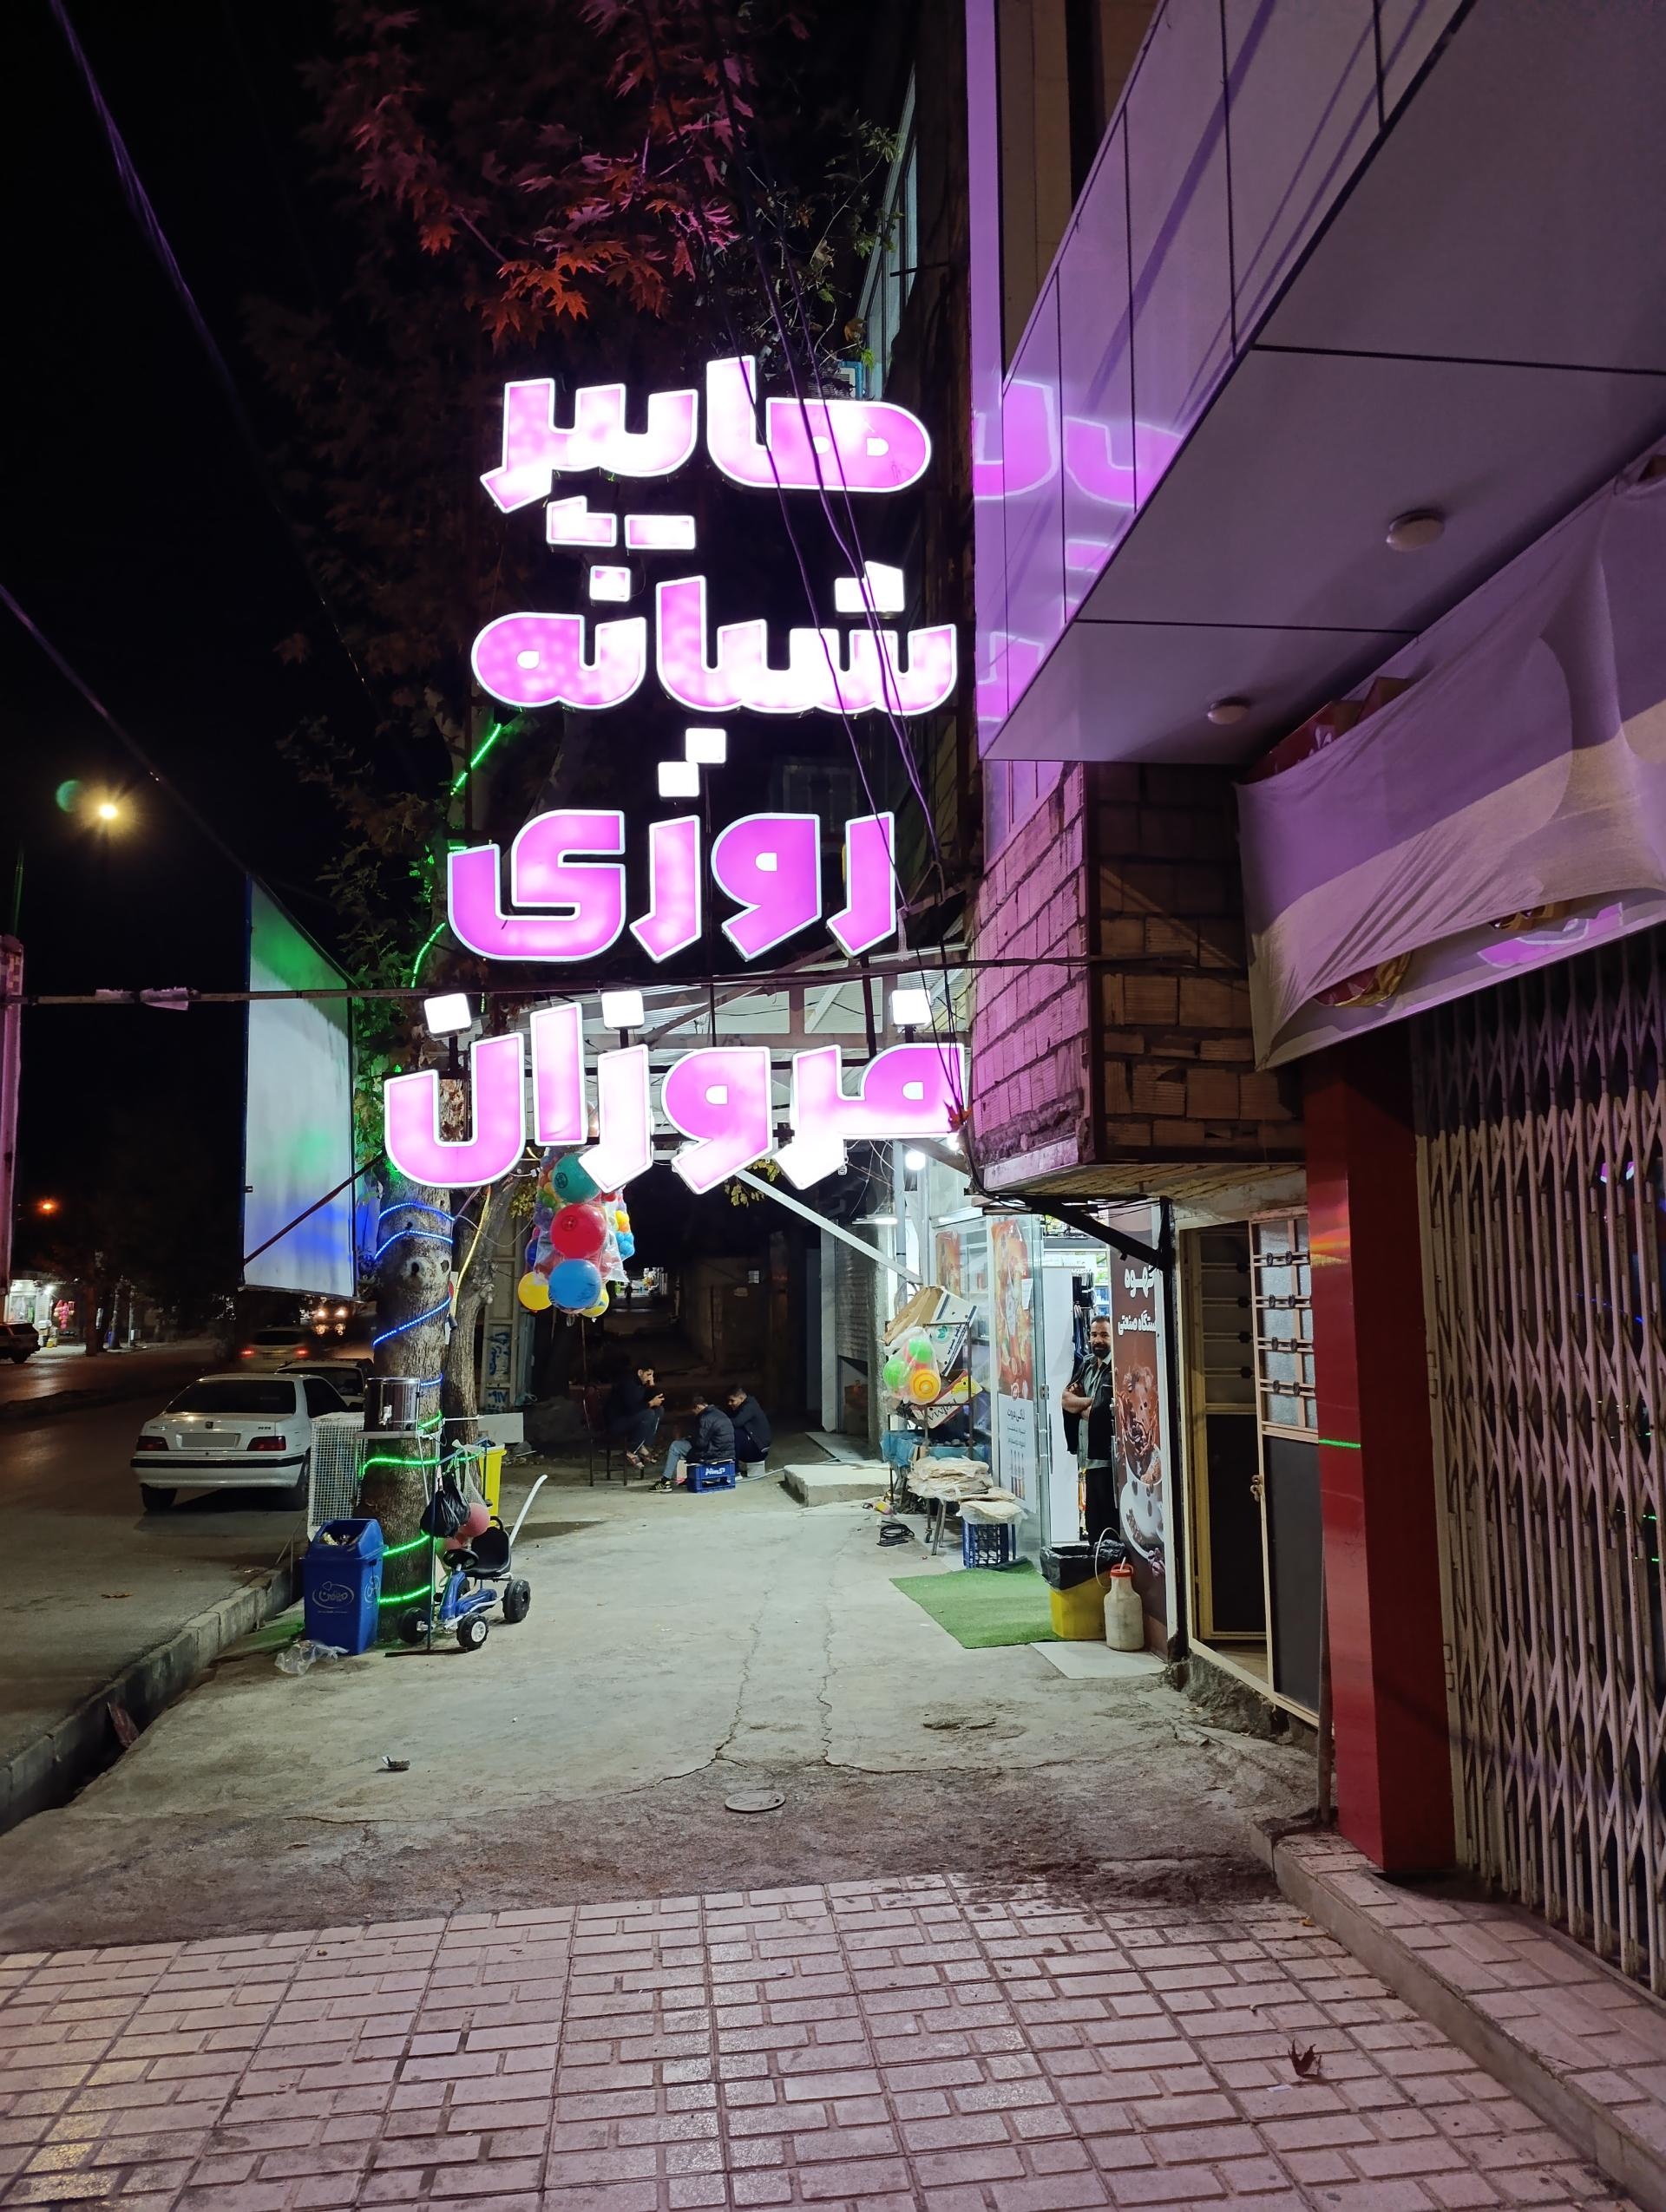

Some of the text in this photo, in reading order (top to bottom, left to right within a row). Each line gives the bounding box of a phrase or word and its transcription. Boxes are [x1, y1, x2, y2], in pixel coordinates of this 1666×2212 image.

[480, 355, 932, 550] هایپر
[470, 560, 957, 765] شبانه
[447, 761, 896, 963] روزی
[384, 990, 969, 1194] فروزان
